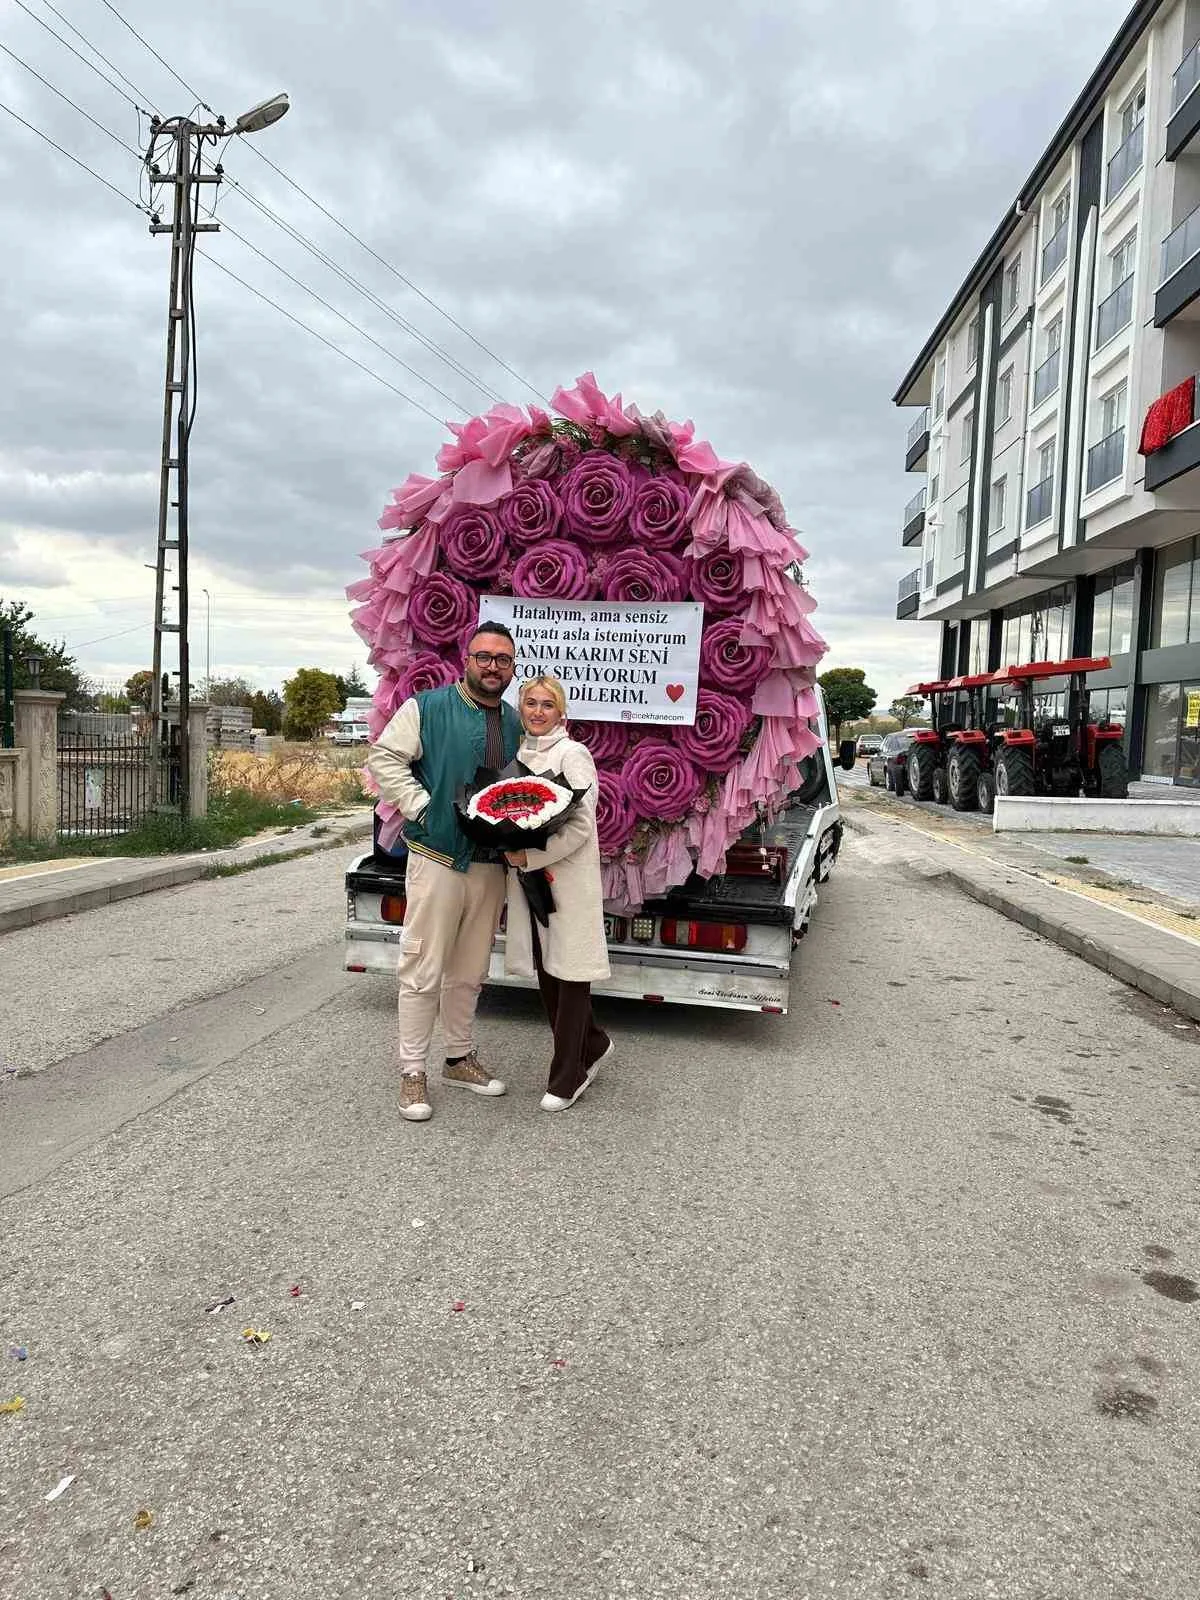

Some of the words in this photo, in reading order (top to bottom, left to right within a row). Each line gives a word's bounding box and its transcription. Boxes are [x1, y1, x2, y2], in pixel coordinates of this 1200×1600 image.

[512, 604, 586, 624] Hatalıyım,
[590, 611, 621, 623] ama
[625, 609, 668, 624] sensiz
[515, 624, 559, 643] hayatı
[563, 628, 590, 641] asla
[594, 627, 686, 646] istemiyorum
[515, 644, 560, 660] ANIM
[565, 646, 624, 663] KARIM
[628, 647, 669, 665] SENİ
[513, 663, 549, 683] ÇOK
[553, 663, 658, 684] SEVİYORUM
[569, 685, 648, 705] DİLERİM.
